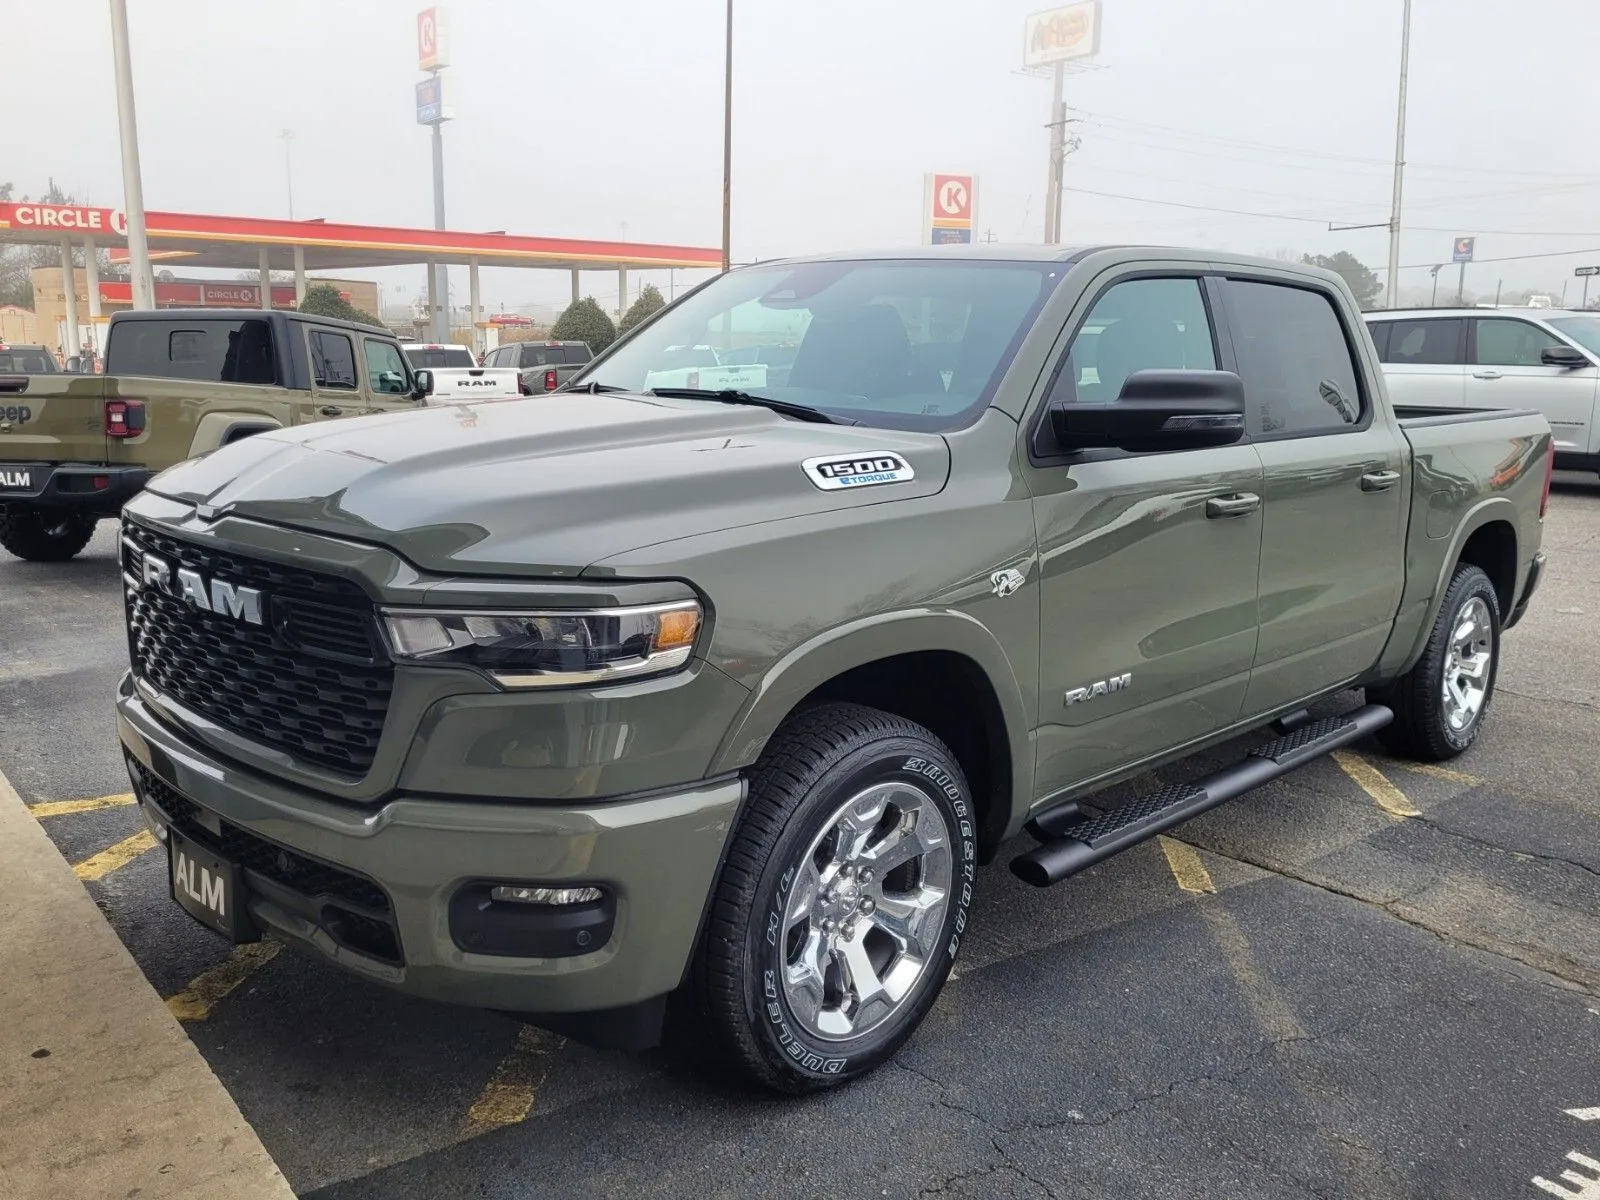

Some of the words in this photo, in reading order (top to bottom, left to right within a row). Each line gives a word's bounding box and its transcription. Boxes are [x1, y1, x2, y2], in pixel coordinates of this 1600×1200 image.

[15, 207, 102, 229] CIRCLE
[207, 291, 239, 299] CIRCLE
[820, 458, 896, 478] 1500
[142, 552, 263, 626] RAM
[1064, 673, 1131, 706] RAM
[176, 851, 225, 916] ALM
[764, 969, 848, 1075] DUELER
